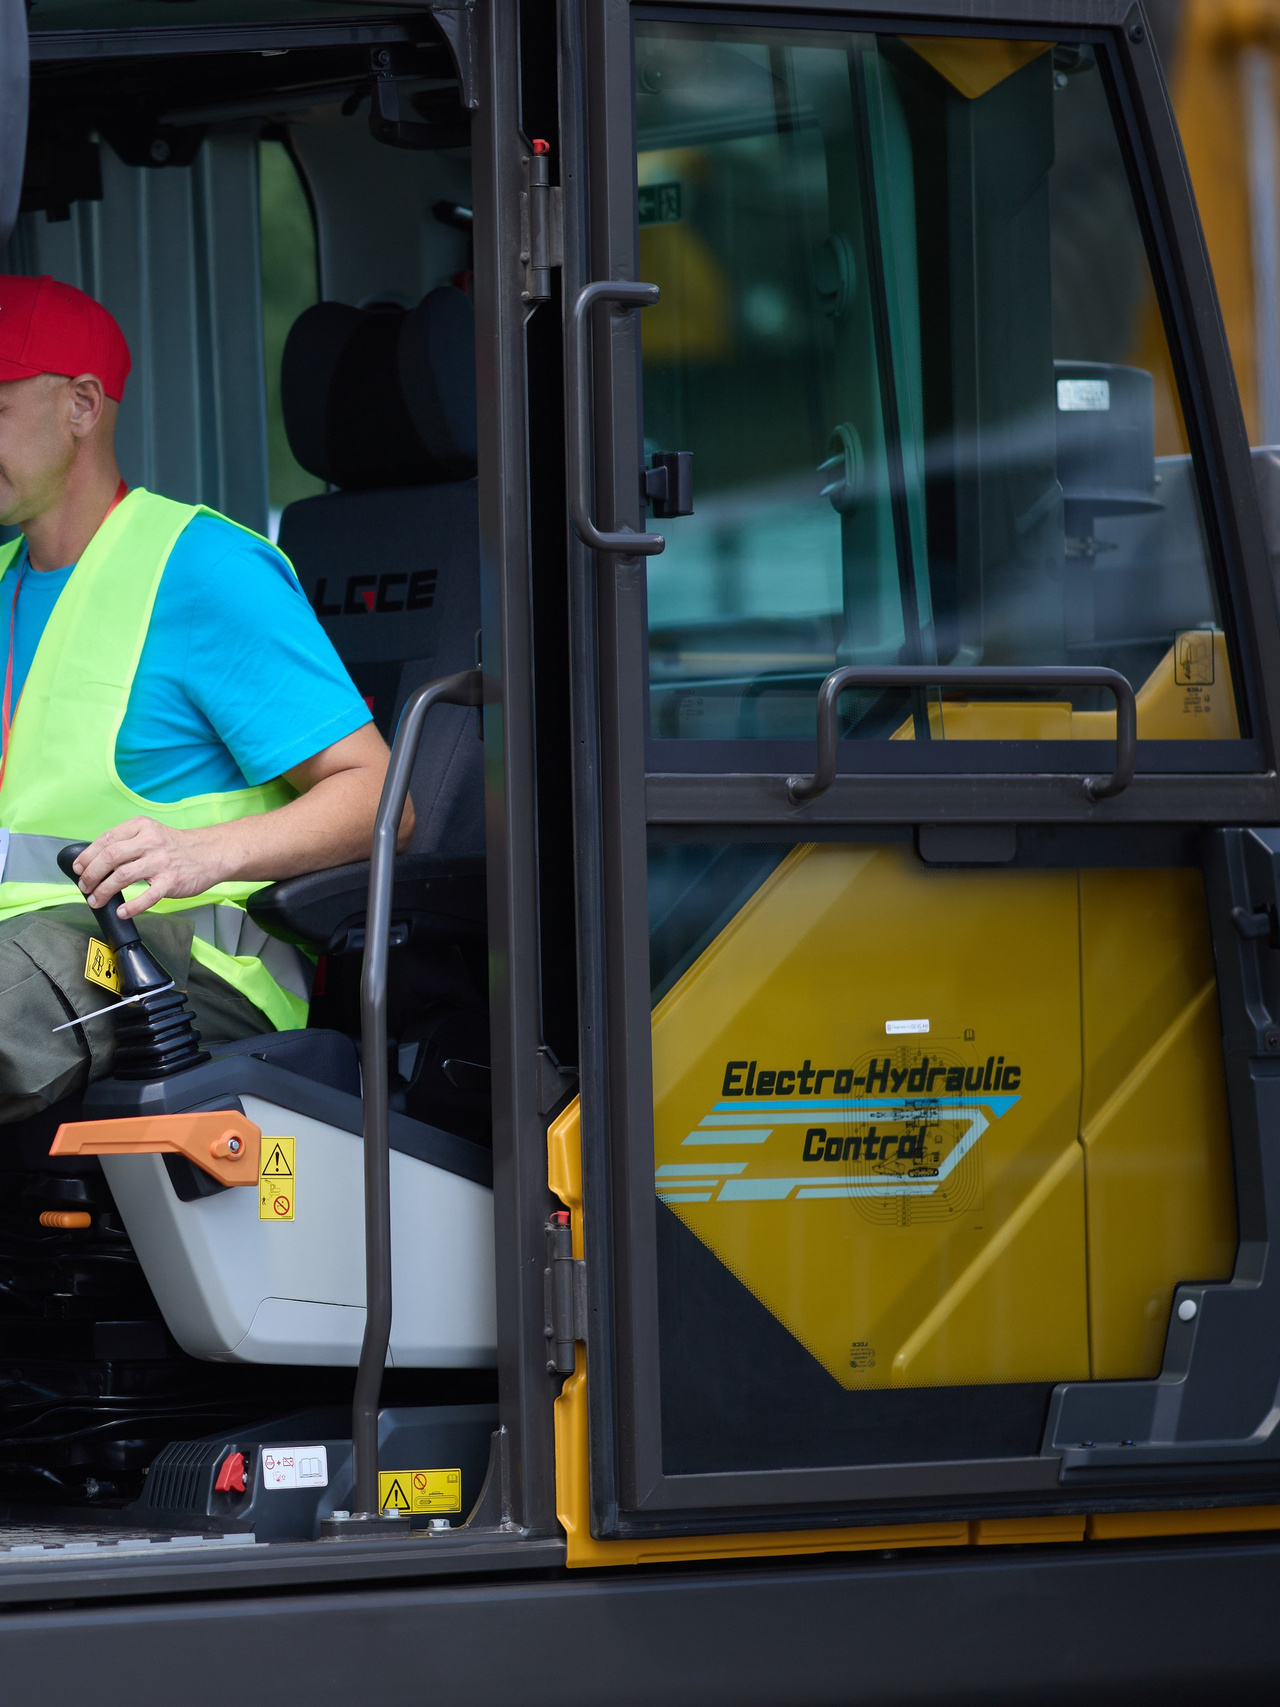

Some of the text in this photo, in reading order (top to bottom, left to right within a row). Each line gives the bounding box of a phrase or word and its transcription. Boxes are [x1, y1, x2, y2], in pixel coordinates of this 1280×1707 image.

[314, 569, 438, 616] LGCE
[721, 1056, 1022, 1096] Electro-Hydraulic
[802, 1126, 927, 1162] Control
